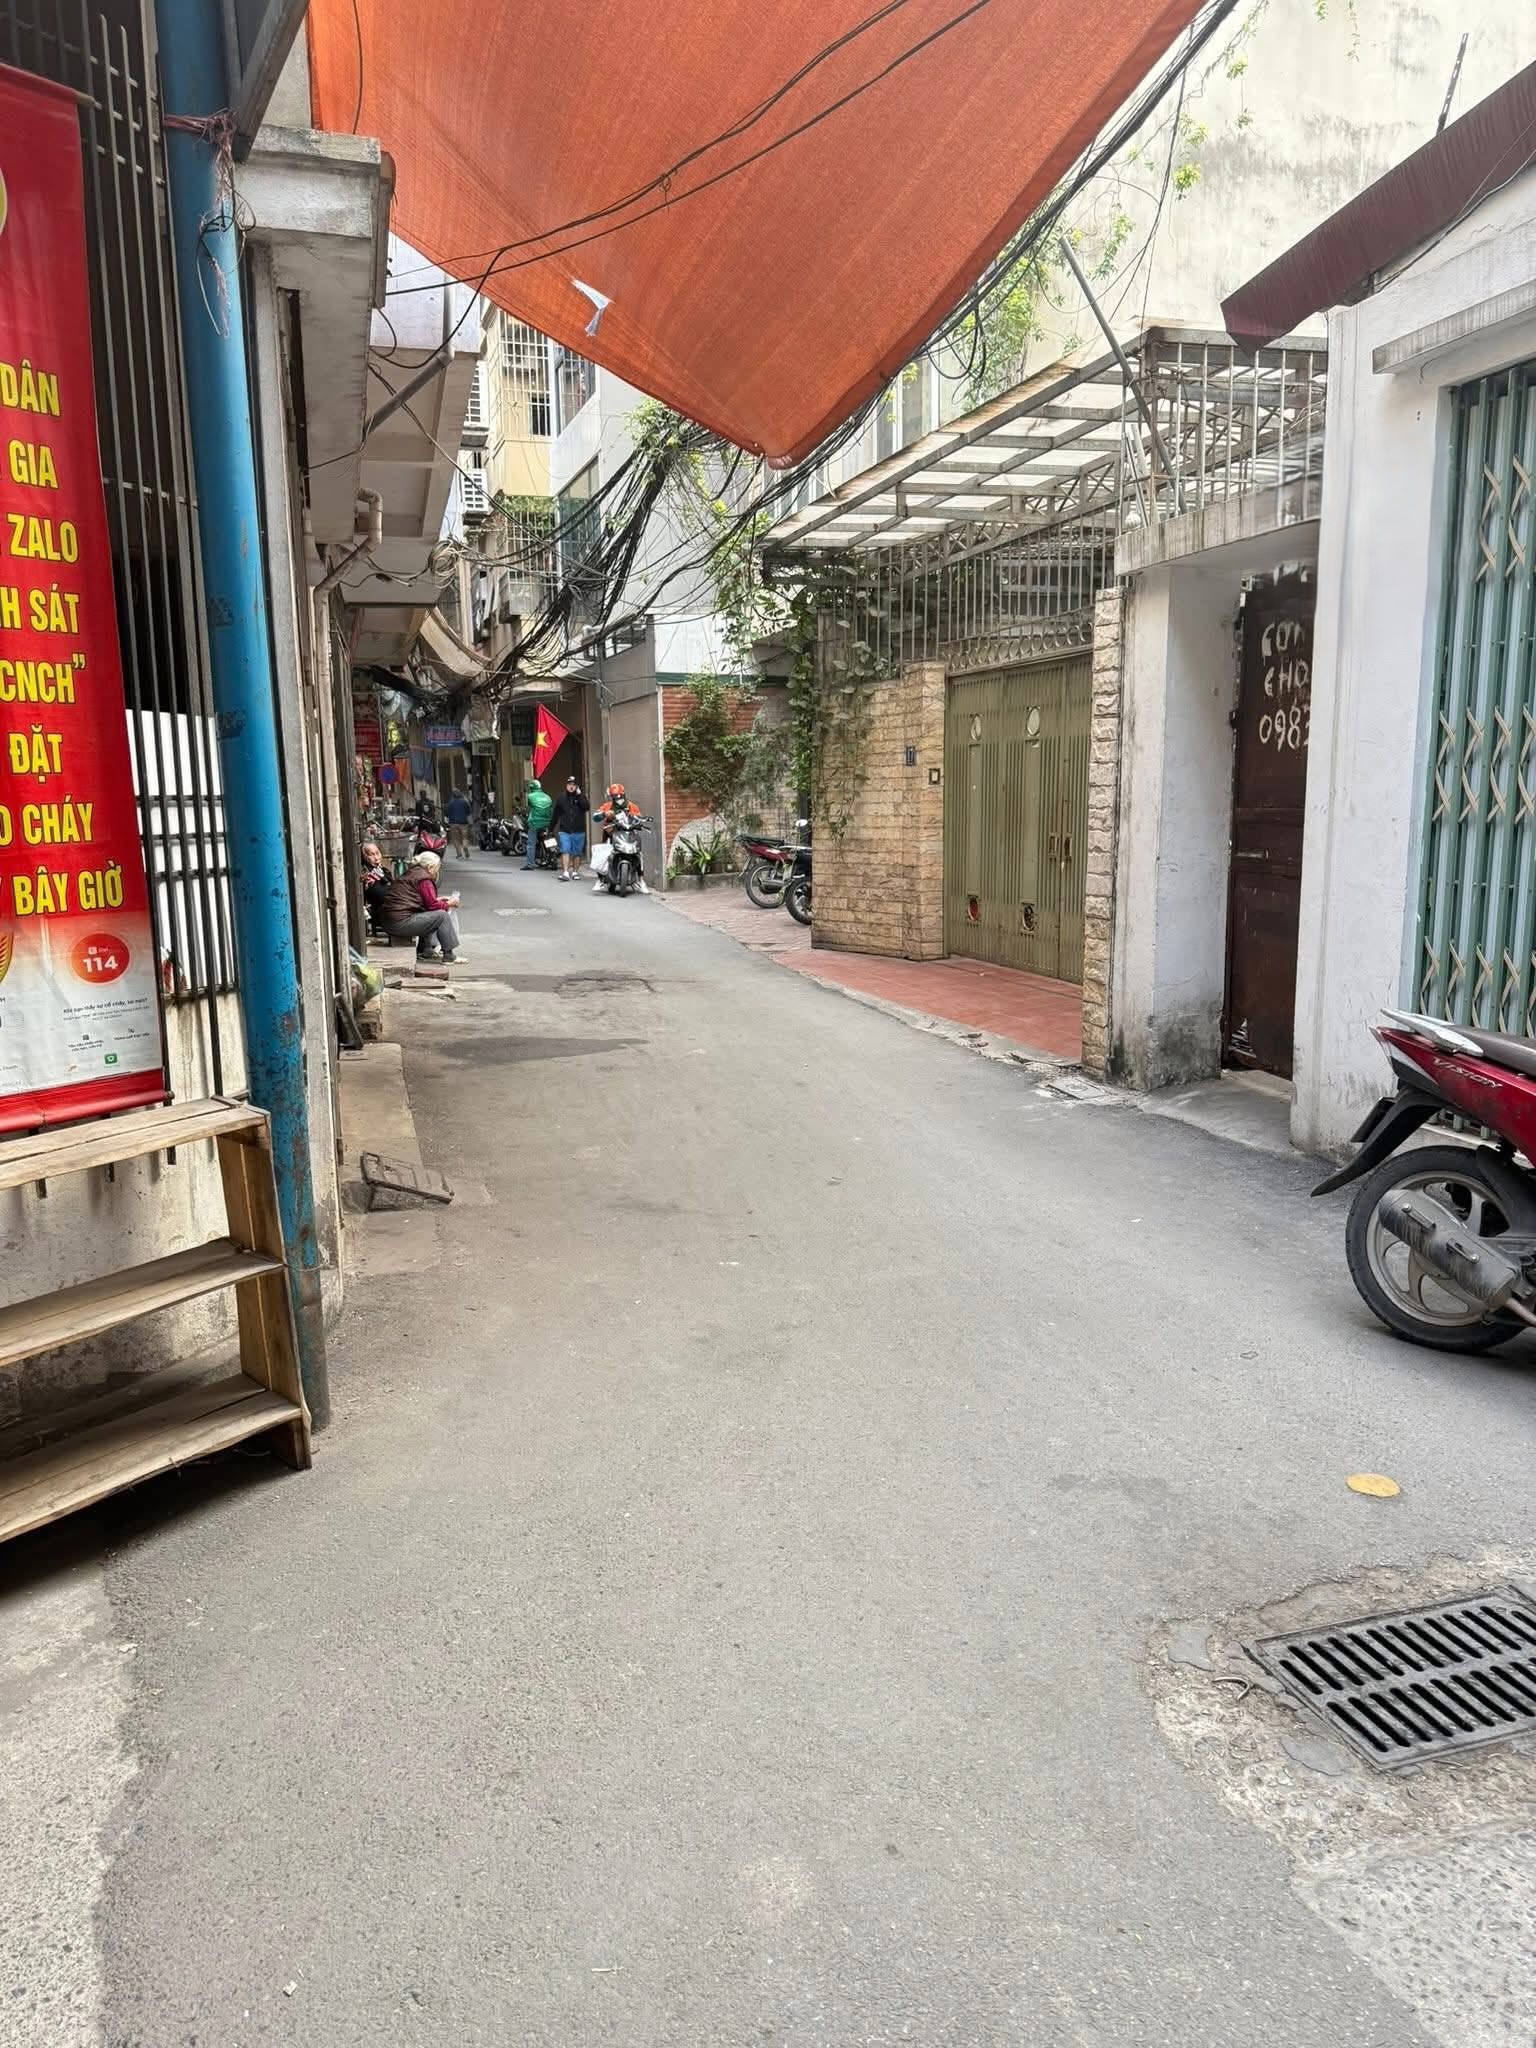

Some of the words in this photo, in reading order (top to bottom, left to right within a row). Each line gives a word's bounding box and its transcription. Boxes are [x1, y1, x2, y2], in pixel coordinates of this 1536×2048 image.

[0, 358, 61, 417] DÂN
[9, 439, 59, 490] GIA
[7, 513, 79, 563] ZALO
[29, 583, 80, 634] SÁT
[8, 723, 63, 784] ĐẶT
[22, 794, 94, 845] CHÁY
[12, 865, 68, 915] BÂY
[77, 860, 124, 911] GIỜ
[83, 955, 118, 973] 114
[1432, 1057, 1503, 1089] VISION
